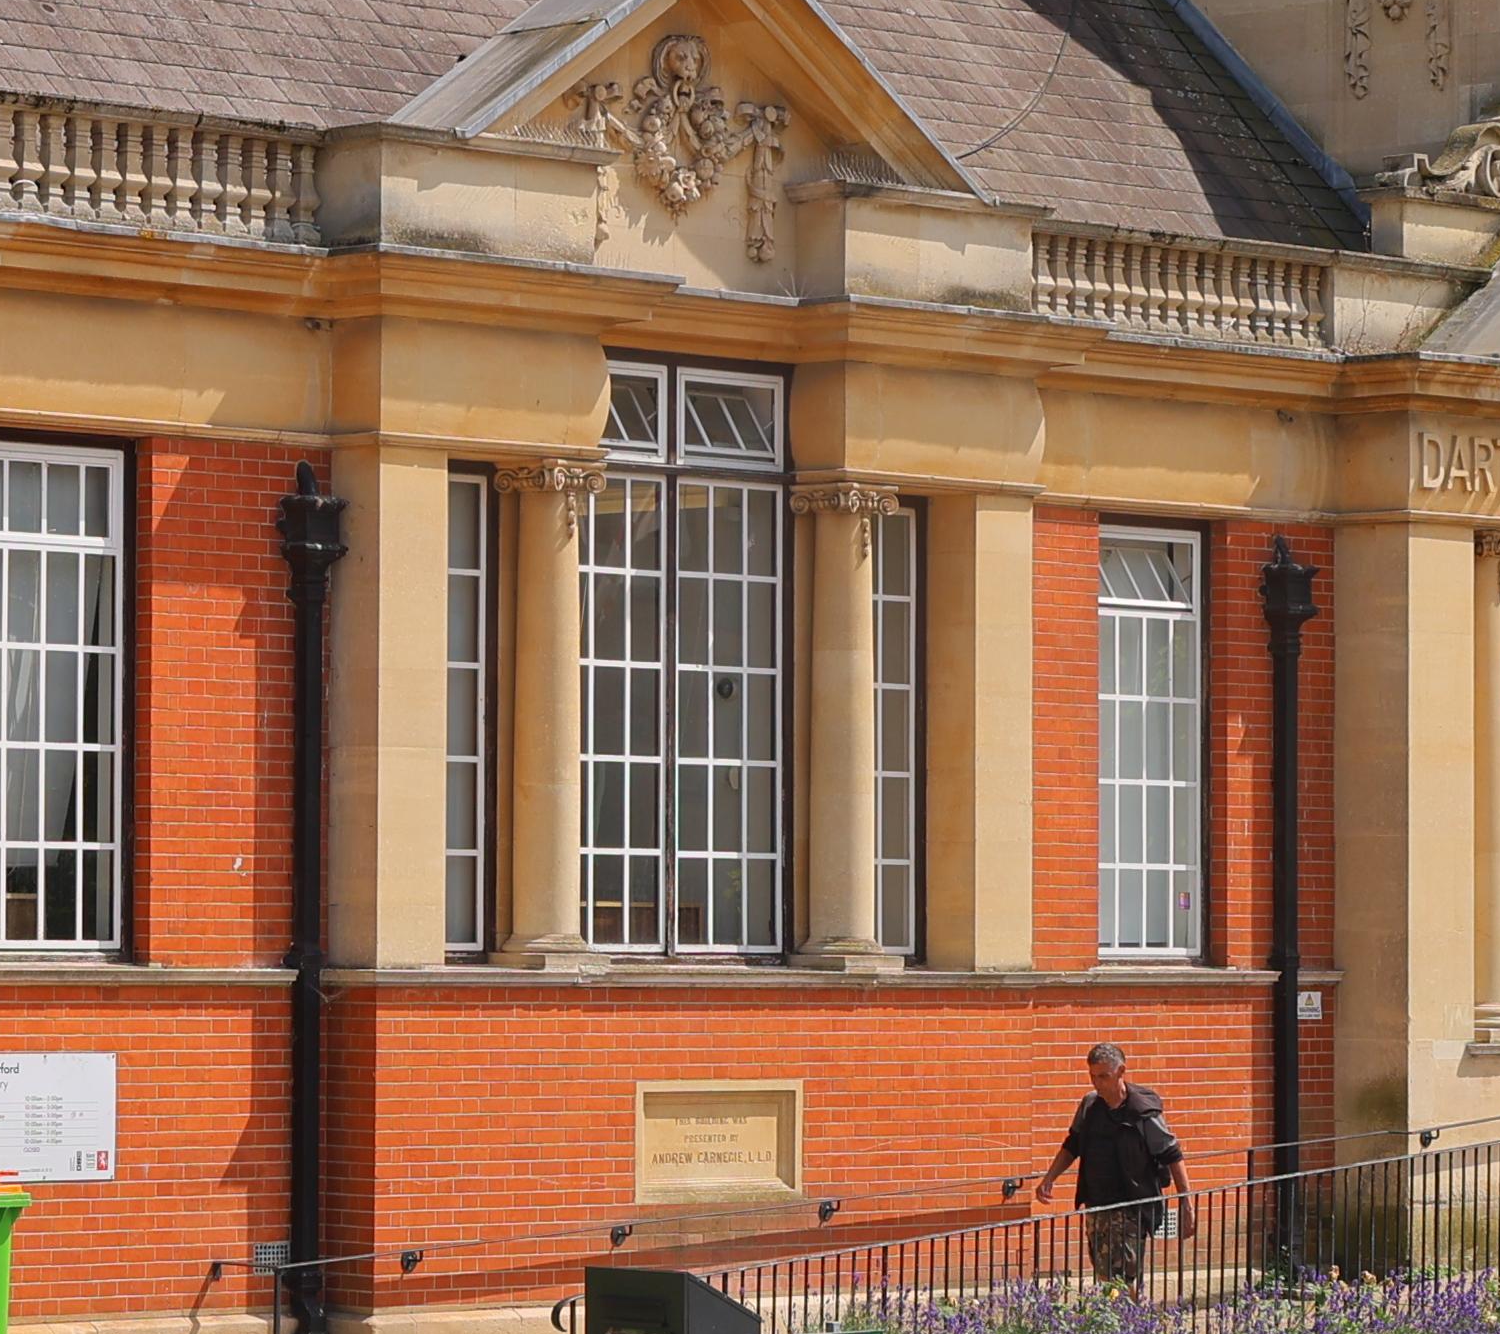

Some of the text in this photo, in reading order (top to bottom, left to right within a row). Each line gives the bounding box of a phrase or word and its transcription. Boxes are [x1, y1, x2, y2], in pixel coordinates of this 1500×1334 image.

[684, 1134, 739, 1143] PRESENTED BY
[652, 1152, 693, 1165] ANDREW
